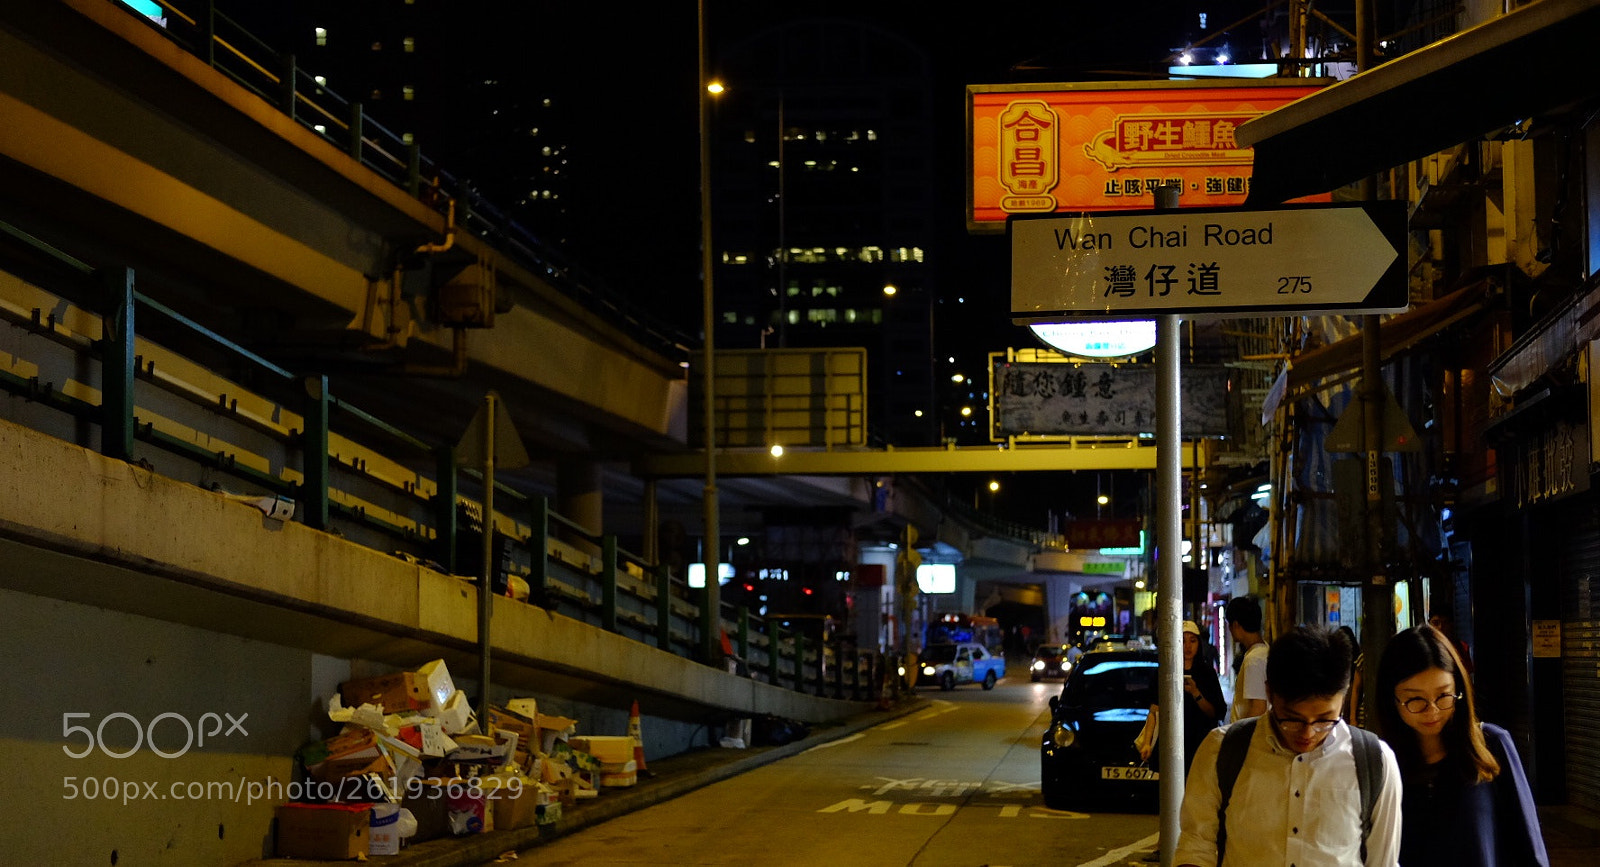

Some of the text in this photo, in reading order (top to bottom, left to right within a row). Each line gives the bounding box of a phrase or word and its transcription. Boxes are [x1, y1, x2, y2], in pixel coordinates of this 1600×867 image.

[1004, 110, 1051, 177] 合昌
[1054, 222, 1273, 251] Wan Chai Road
[1103, 262, 1222, 298] 灣仔道
[1278, 276, 1312, 295] 275
[1104, 768, 1121, 779] TS
